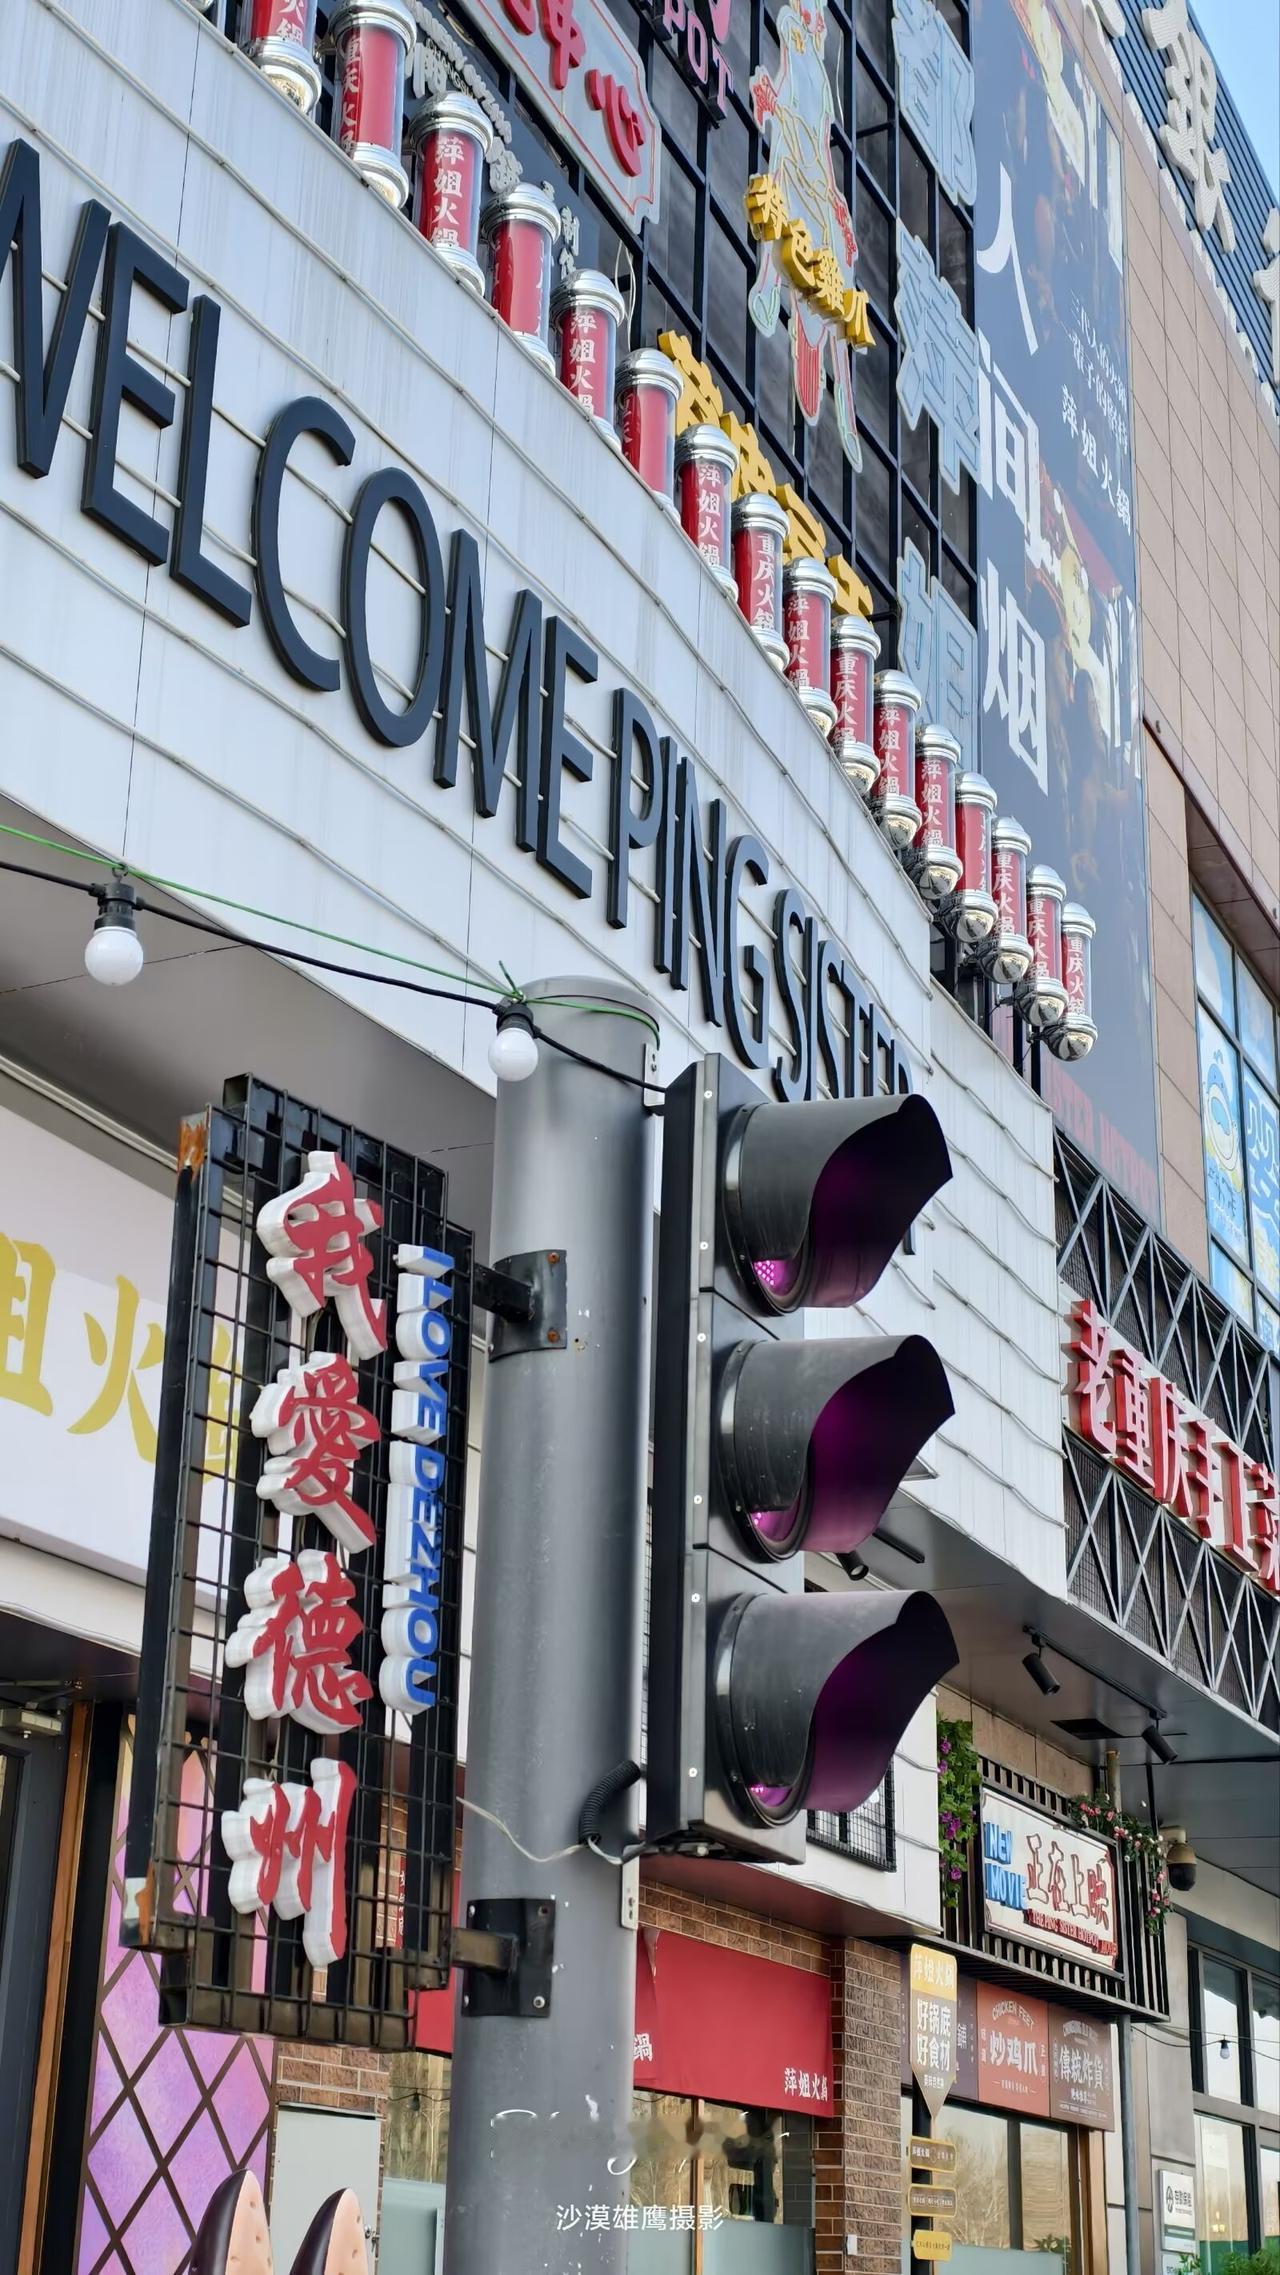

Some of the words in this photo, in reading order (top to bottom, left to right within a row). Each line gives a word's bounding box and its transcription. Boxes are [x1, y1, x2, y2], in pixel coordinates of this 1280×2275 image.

[745, 174, 876, 346] 特色雞爪
[0, 138, 598, 900] WELCOME
[606, 688, 770, 1070] PING
[398, 1272, 453, 1446] LOVE
[235, 1150, 389, 1965] 我愛德州
[388, 1440, 449, 1711] DEZHOU
[984, 1822, 1012, 1864] NEW
[1026, 1833, 1109, 1931] 正在上映
[916, 2034, 951, 2072] 好食材
[917, 1999, 952, 2037] 好锅底
[989, 2030, 1039, 2076] 炒鸡爪
